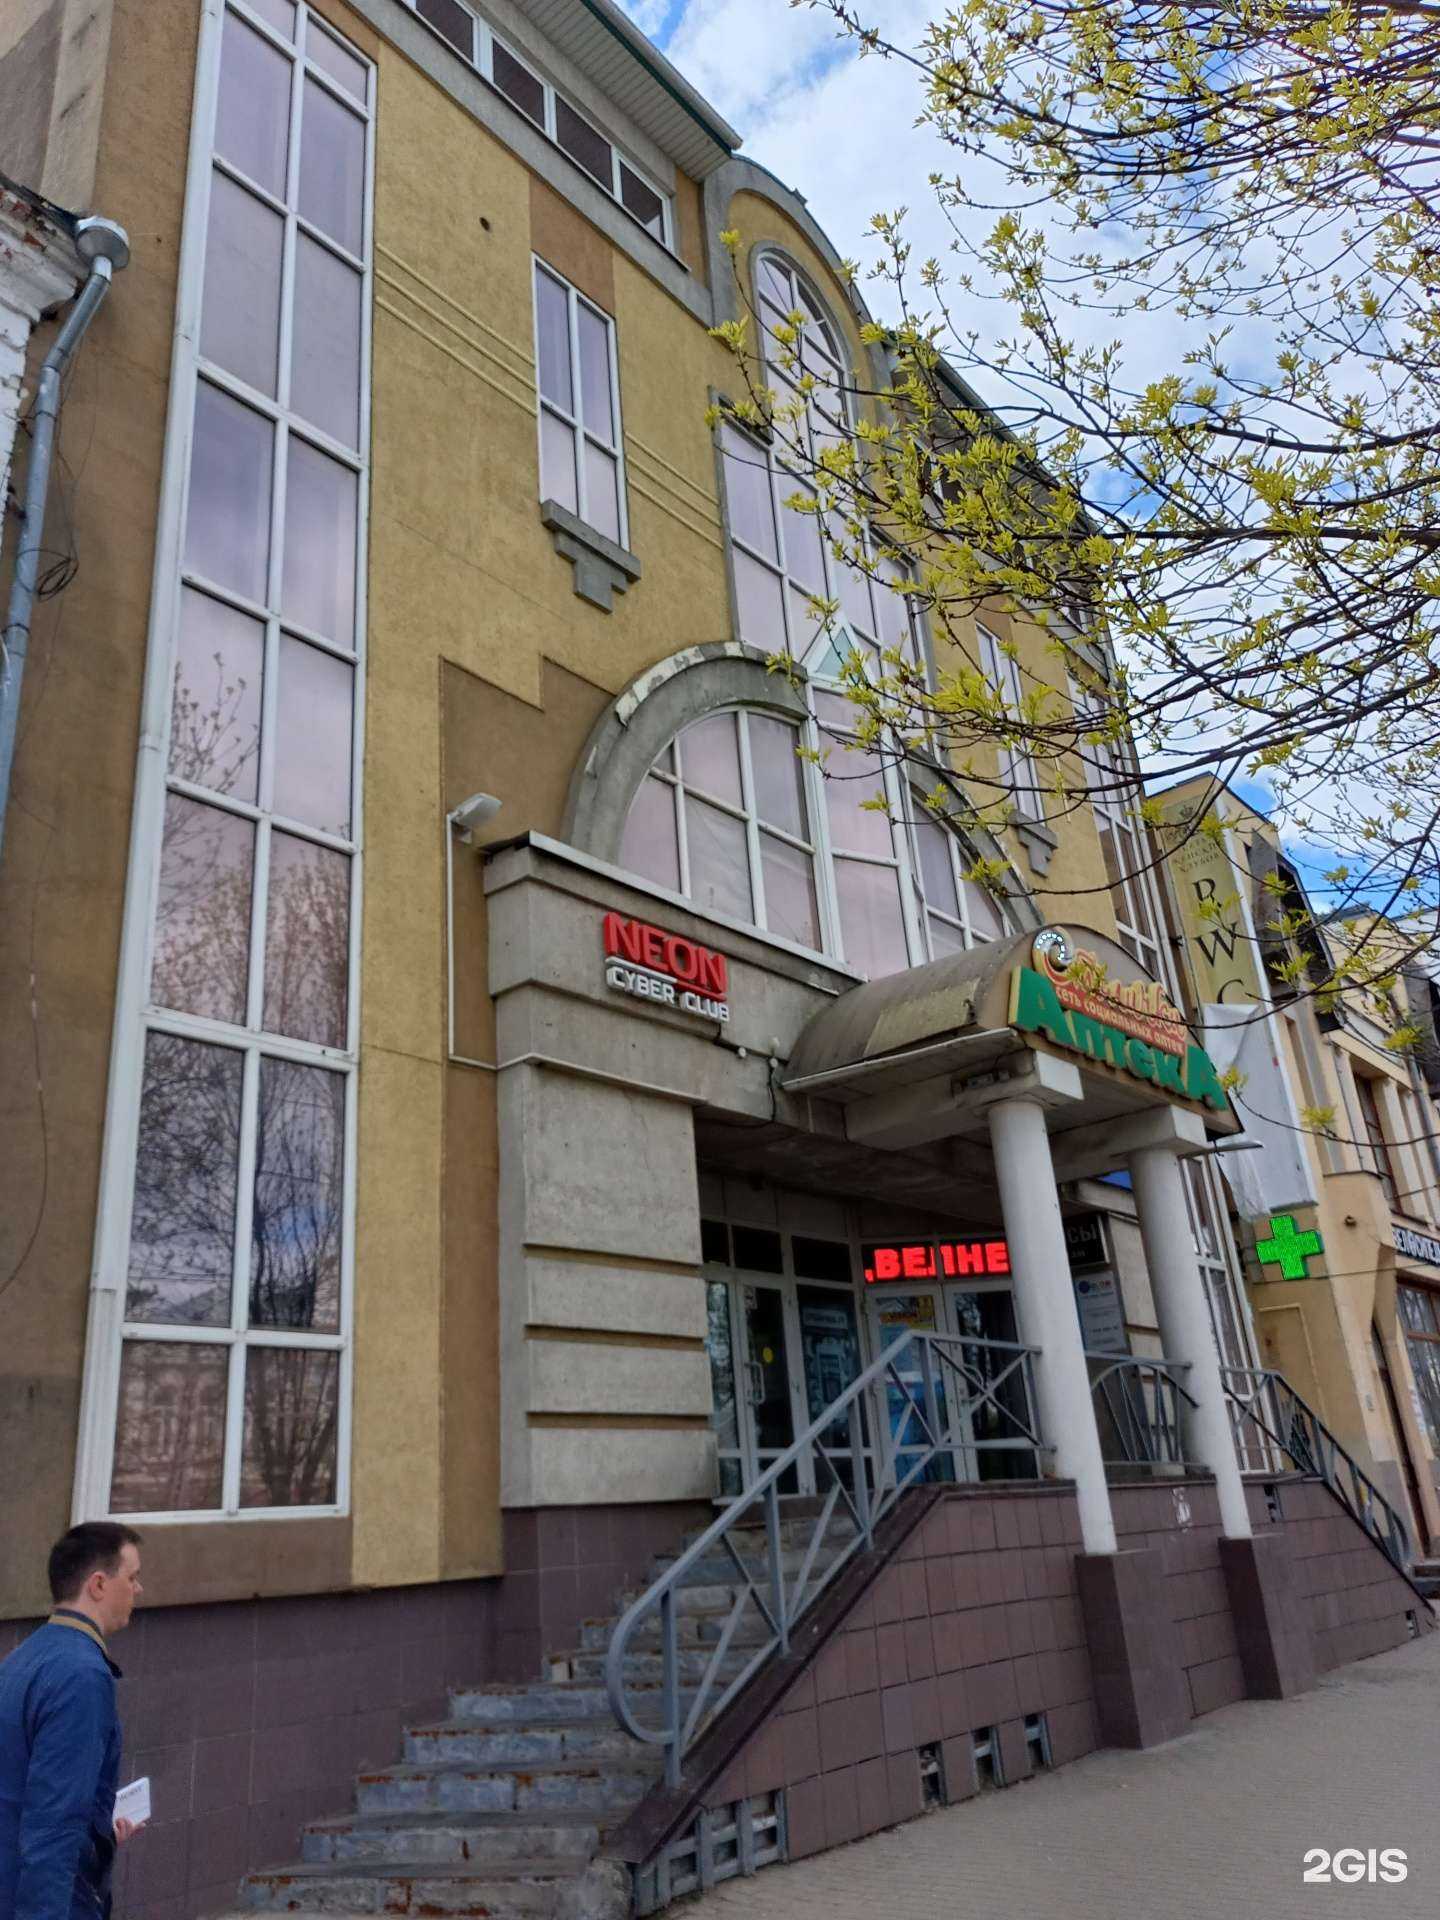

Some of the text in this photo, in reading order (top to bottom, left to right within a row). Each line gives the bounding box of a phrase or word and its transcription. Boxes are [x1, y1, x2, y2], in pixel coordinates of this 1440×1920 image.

[603, 912, 729, 995] NEON
[606, 966, 730, 1024] CYBER CLUB
